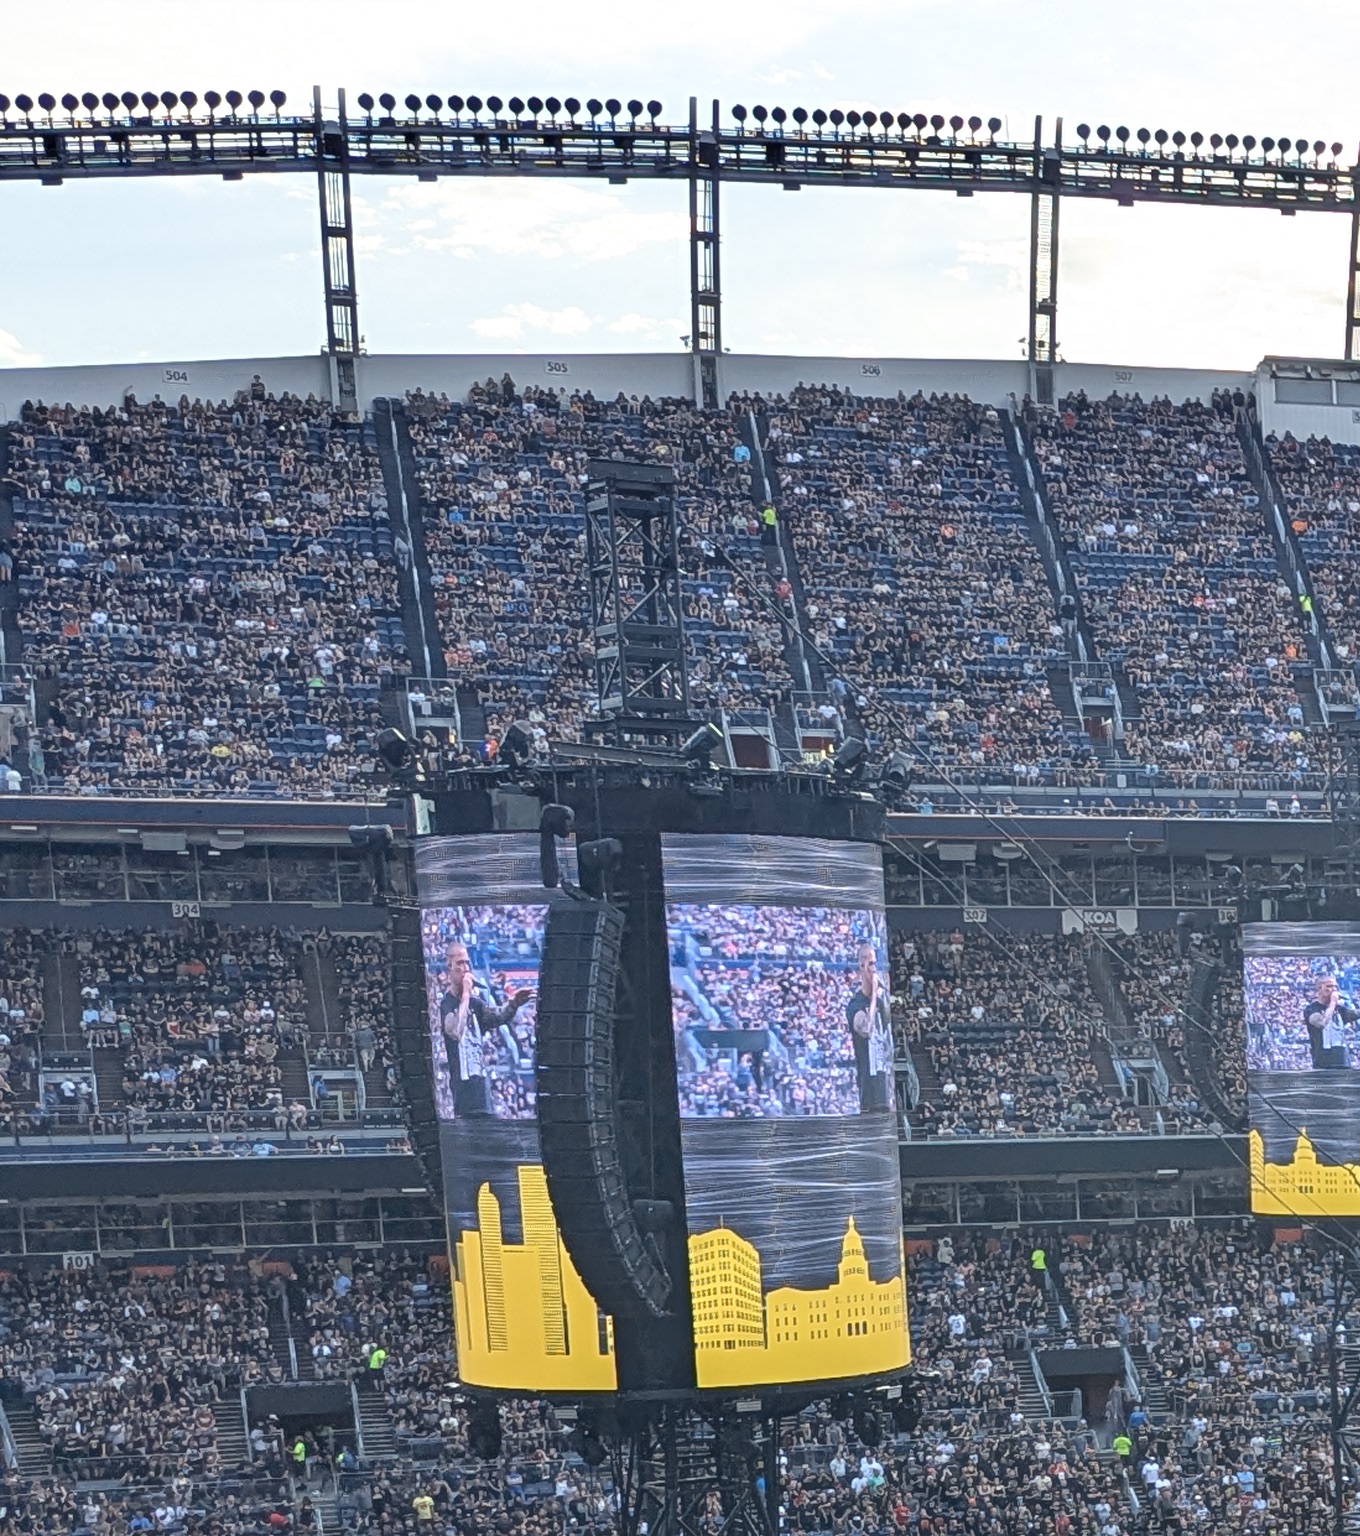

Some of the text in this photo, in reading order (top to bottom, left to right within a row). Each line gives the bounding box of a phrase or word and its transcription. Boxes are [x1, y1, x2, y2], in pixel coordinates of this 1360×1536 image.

[547, 361, 568, 373] 505
[166, 370, 188, 382] 504
[1115, 371, 1133, 382] 507
[175, 904, 199, 916] 304
[1083, 911, 1116, 924] KOA
